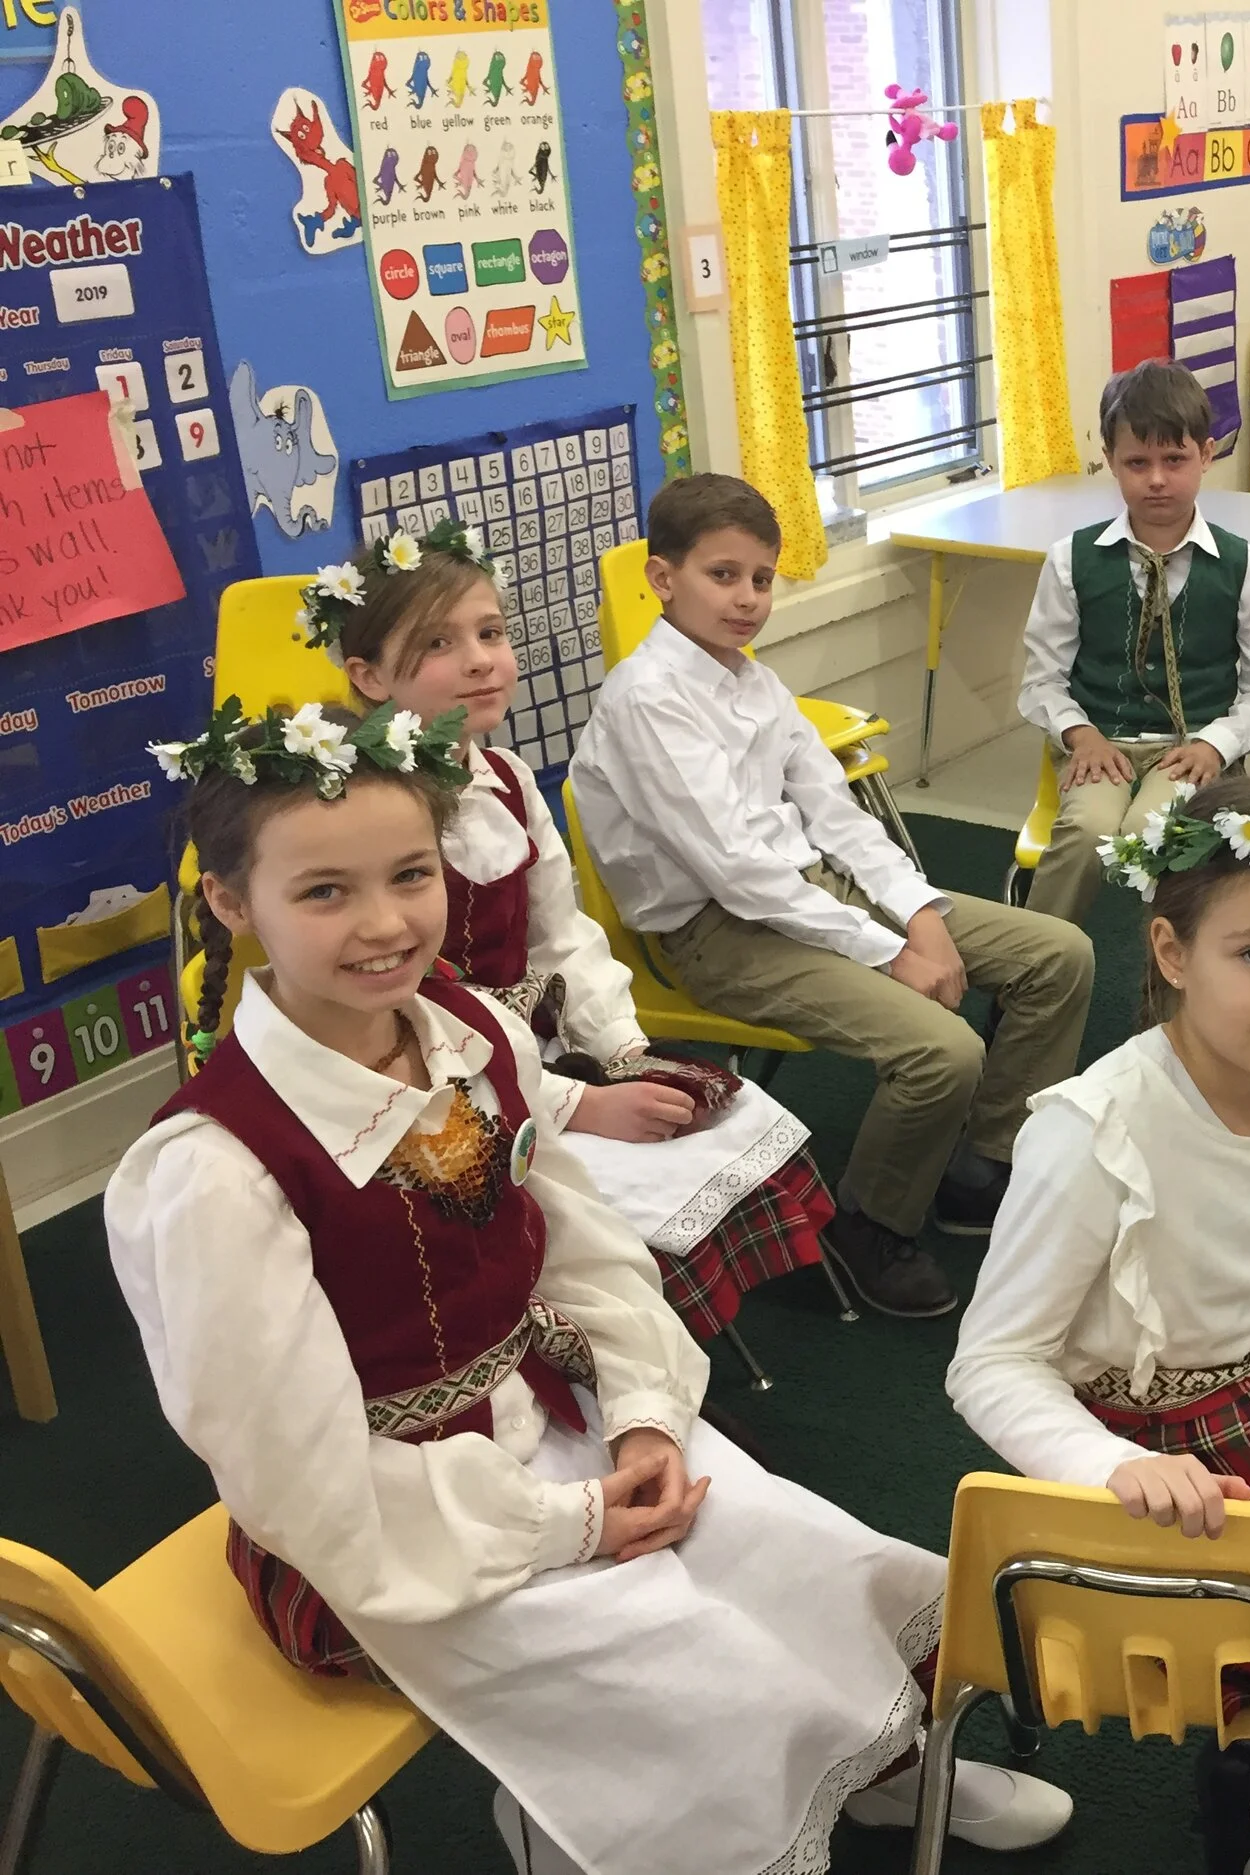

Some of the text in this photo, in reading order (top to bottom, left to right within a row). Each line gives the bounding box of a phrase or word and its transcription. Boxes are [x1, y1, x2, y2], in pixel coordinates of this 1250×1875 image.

[384, 0, 448, 21] Colors
[472, 0, 540, 32] Shapes
[370, 114, 552, 132] red blue yellow green orange
[1177, 96, 1197, 119] Aa
[1218, 90, 1236, 112] Bb
[1170, 145, 1198, 177] Aa
[1211, 140, 1234, 173] Bb
[372, 199, 555, 229] purple brown pink white black
[0, 213, 142, 269] Weather
[850, 244, 878, 262] window
[384, 250, 568, 281] circle square rectangle octagon
[701, 258, 710, 278] 3
[0, 286, 108, 330] Year 2019
[24, 338, 202, 374] Thursday Friday Saturday
[400, 318, 566, 366] triangle oval rhombus star
[178, 364, 195, 390] 2
[4, 432, 57, 473] not
[190, 422, 204, 448] 9
[374, 432, 624, 506] 1 2 3 4 5 6 7 8 9 10
[489, 462, 630, 513] 15 16 17 18 19 20
[40, 476, 127, 518] items
[520, 500, 610, 540] 26 27 28 29
[26, 518, 118, 567] wall.
[521, 552, 538, 572] 36
[548, 545, 564, 564] 37
[574, 538, 590, 557] 38
[596, 531, 612, 550] 39
[42, 565, 112, 623] you!
[550, 568, 594, 595] 47 48
[529, 601, 595, 636] 56 57 58
[532, 636, 577, 666] 66 67
[66, 674, 166, 713] Tomorrow
[0, 780, 152, 846] Today's Weather
[30, 994, 168, 1085] 9 10 11
